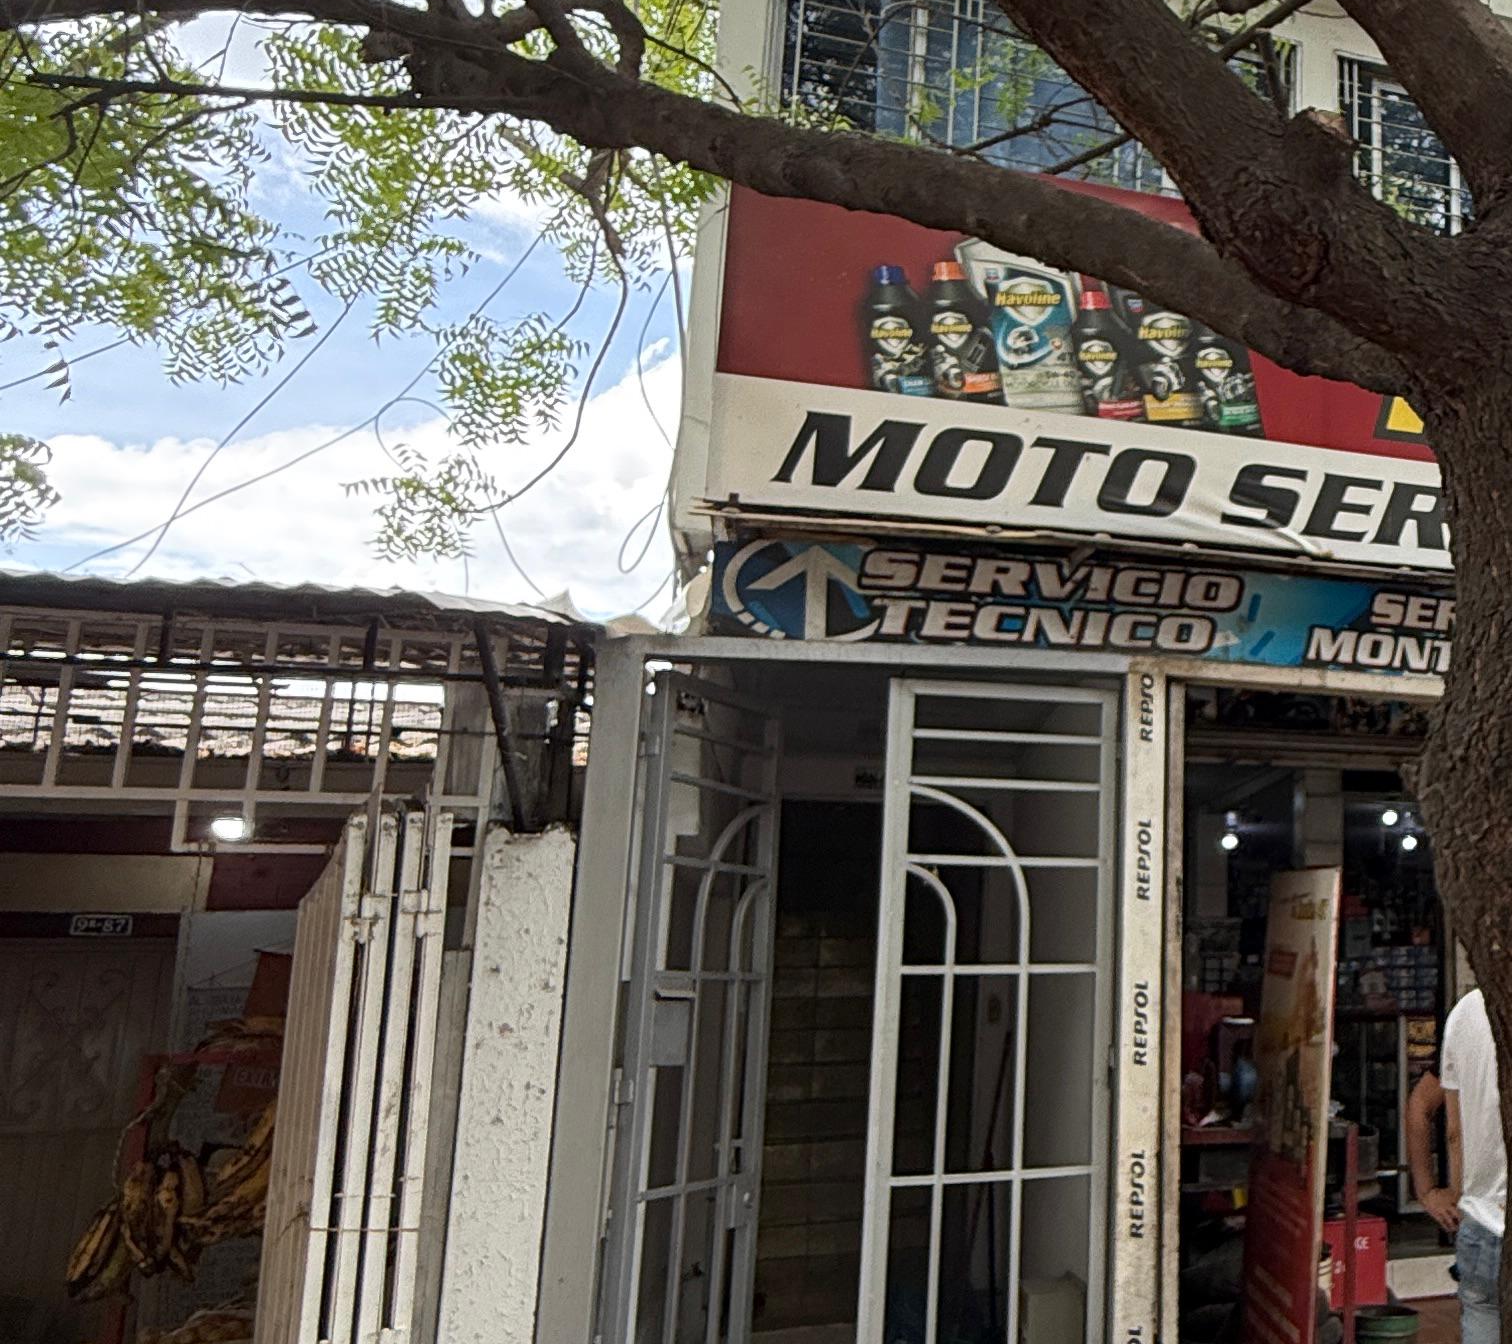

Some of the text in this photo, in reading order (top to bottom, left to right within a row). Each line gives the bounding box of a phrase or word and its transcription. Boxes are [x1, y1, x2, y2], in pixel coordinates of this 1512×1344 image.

[995, 291, 1061, 307] Havoline
[771, 411, 1197, 518] MOTO
[860, 549, 1243, 611] SERVICIO
[872, 598, 1215, 654] TECNICO
[1140, 672, 1155, 743] REPSO
[1136, 818, 1153, 901] REPSOL
[1133, 980, 1149, 1067] REPSOL
[1129, 1148, 1146, 1239] REPSOL
